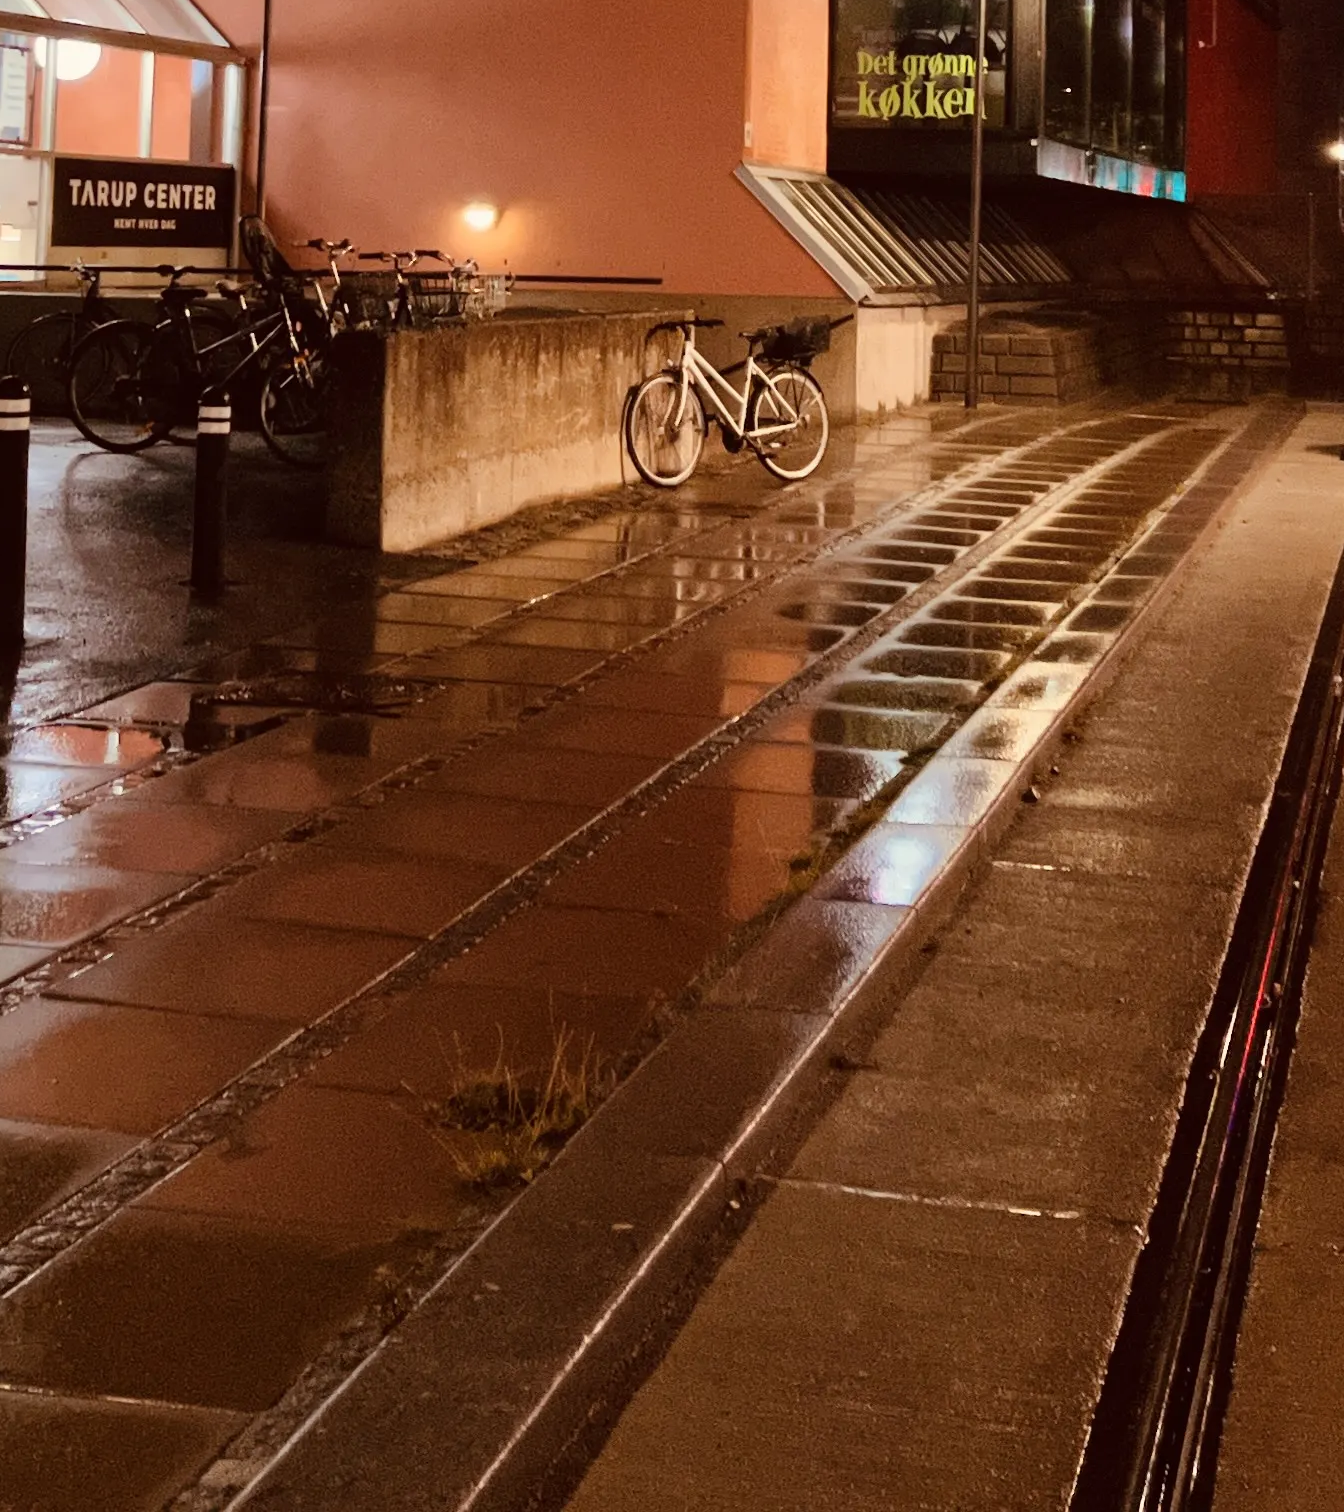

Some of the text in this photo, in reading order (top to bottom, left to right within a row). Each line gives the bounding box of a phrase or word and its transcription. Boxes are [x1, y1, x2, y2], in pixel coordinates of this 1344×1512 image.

[857, 50, 897, 75] Det
[69, 178, 216, 210] TARUP CENTER
